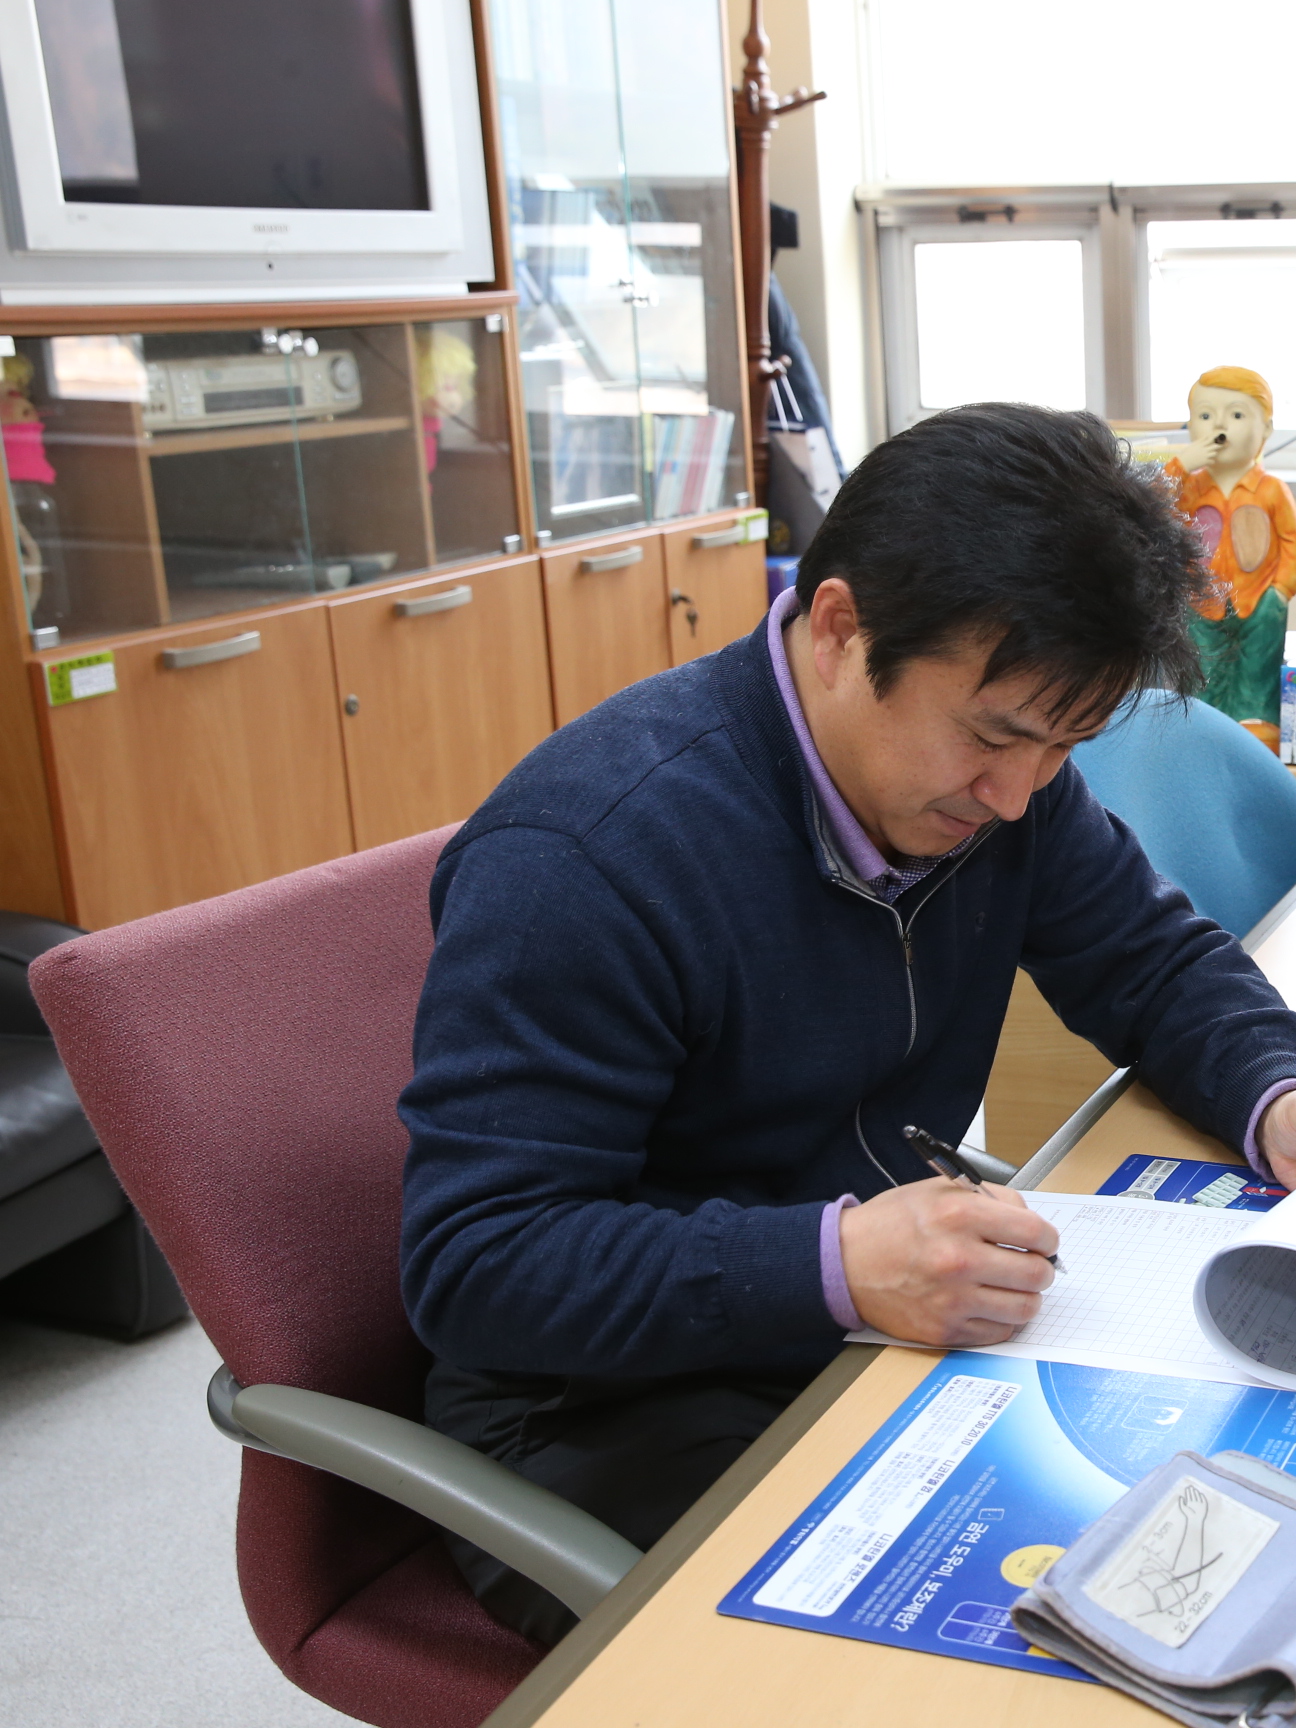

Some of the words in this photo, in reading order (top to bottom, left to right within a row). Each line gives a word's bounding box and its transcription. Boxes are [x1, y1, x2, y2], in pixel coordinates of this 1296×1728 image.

[990, 1385, 1018, 1413] 니코틴엘
[982, 1408, 998, 1424] TTS
[926, 1458, 955, 1487] 니코틴엘
[958, 1519, 990, 1545] 금연
[861, 1532, 892, 1562] 니코틴엘
[929, 1542, 970, 1579] 도우미,
[843, 1560, 867, 1583] 로젠즈
[889, 1579, 941, 1633] 보조제란?
[1187, 1588, 1216, 1617] 32cm
